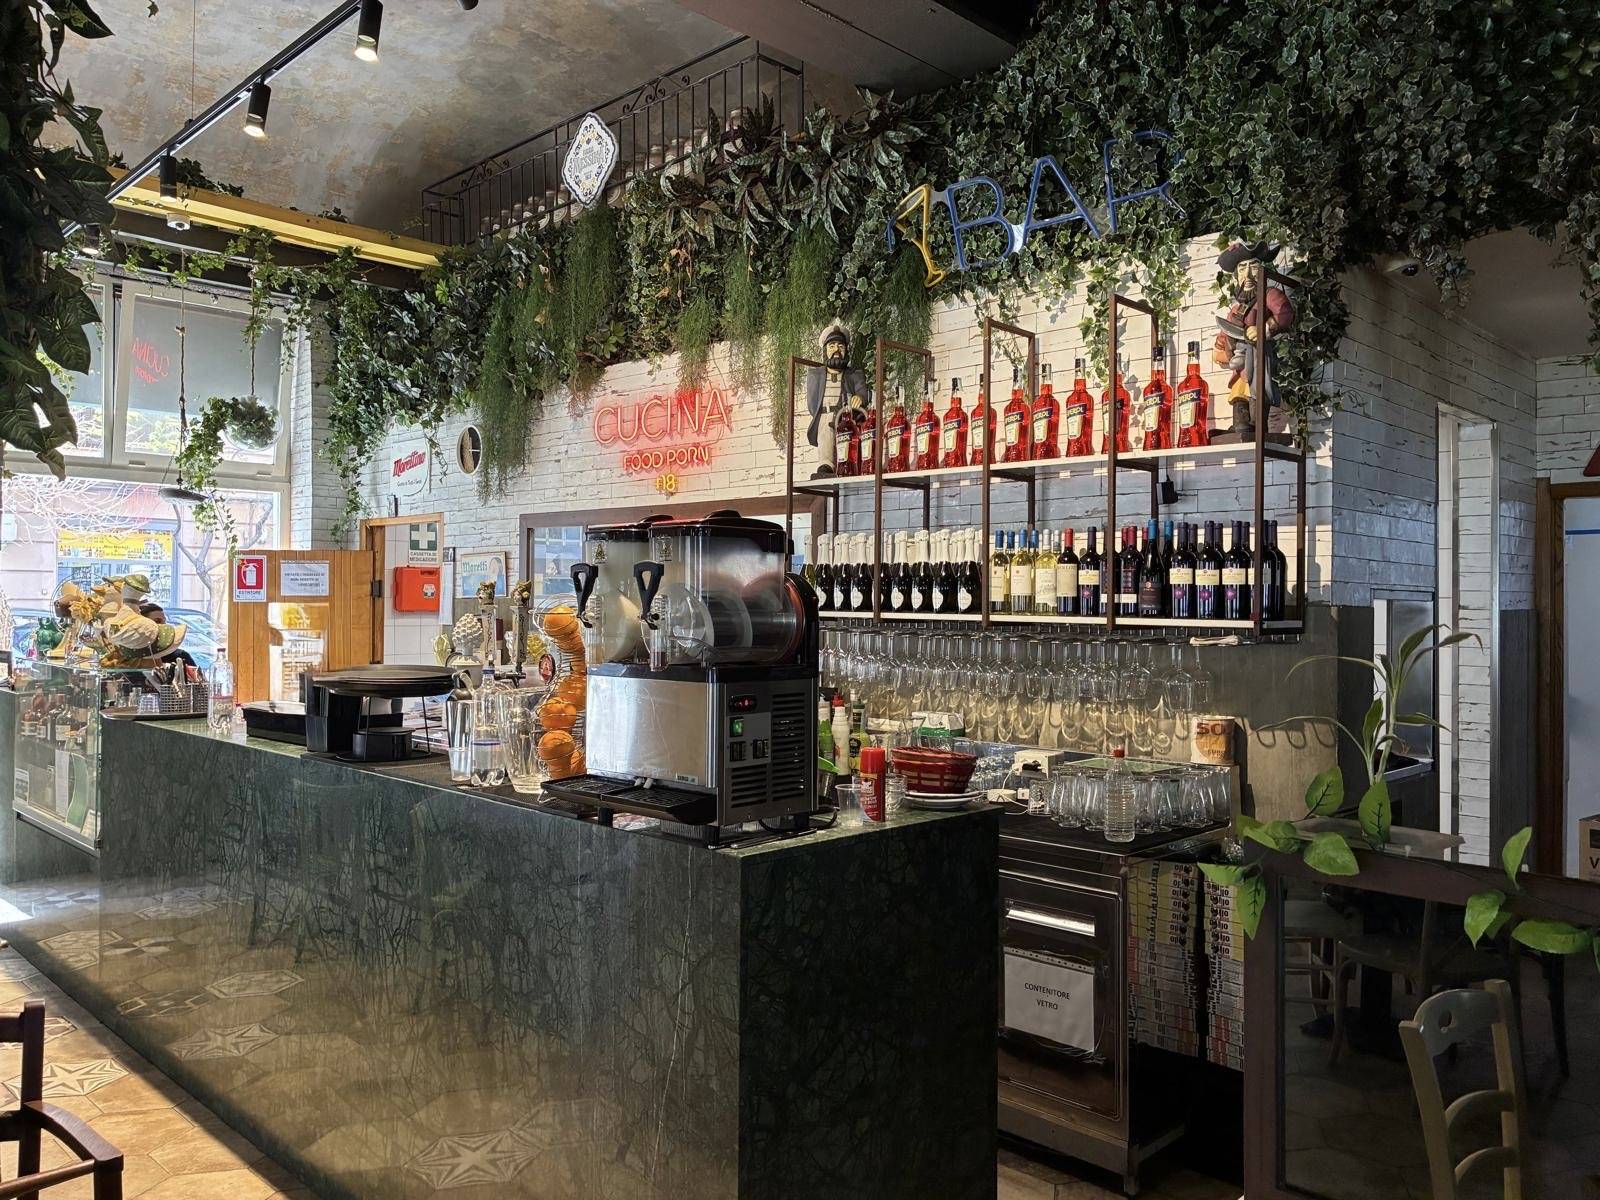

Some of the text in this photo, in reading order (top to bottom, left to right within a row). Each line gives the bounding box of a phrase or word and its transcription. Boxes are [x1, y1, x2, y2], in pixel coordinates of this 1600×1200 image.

[946, 129, 1186, 271] BAR
[594, 388, 730, 445] CUCINA
[624, 446, 709, 470] FOOD PORN
[463, 560, 487, 573] Moretti
[1196, 722, 1226, 735] 50
[1024, 982, 1070, 1000] CONTENITORE
[1036, 998, 1059, 1010] VETRO
